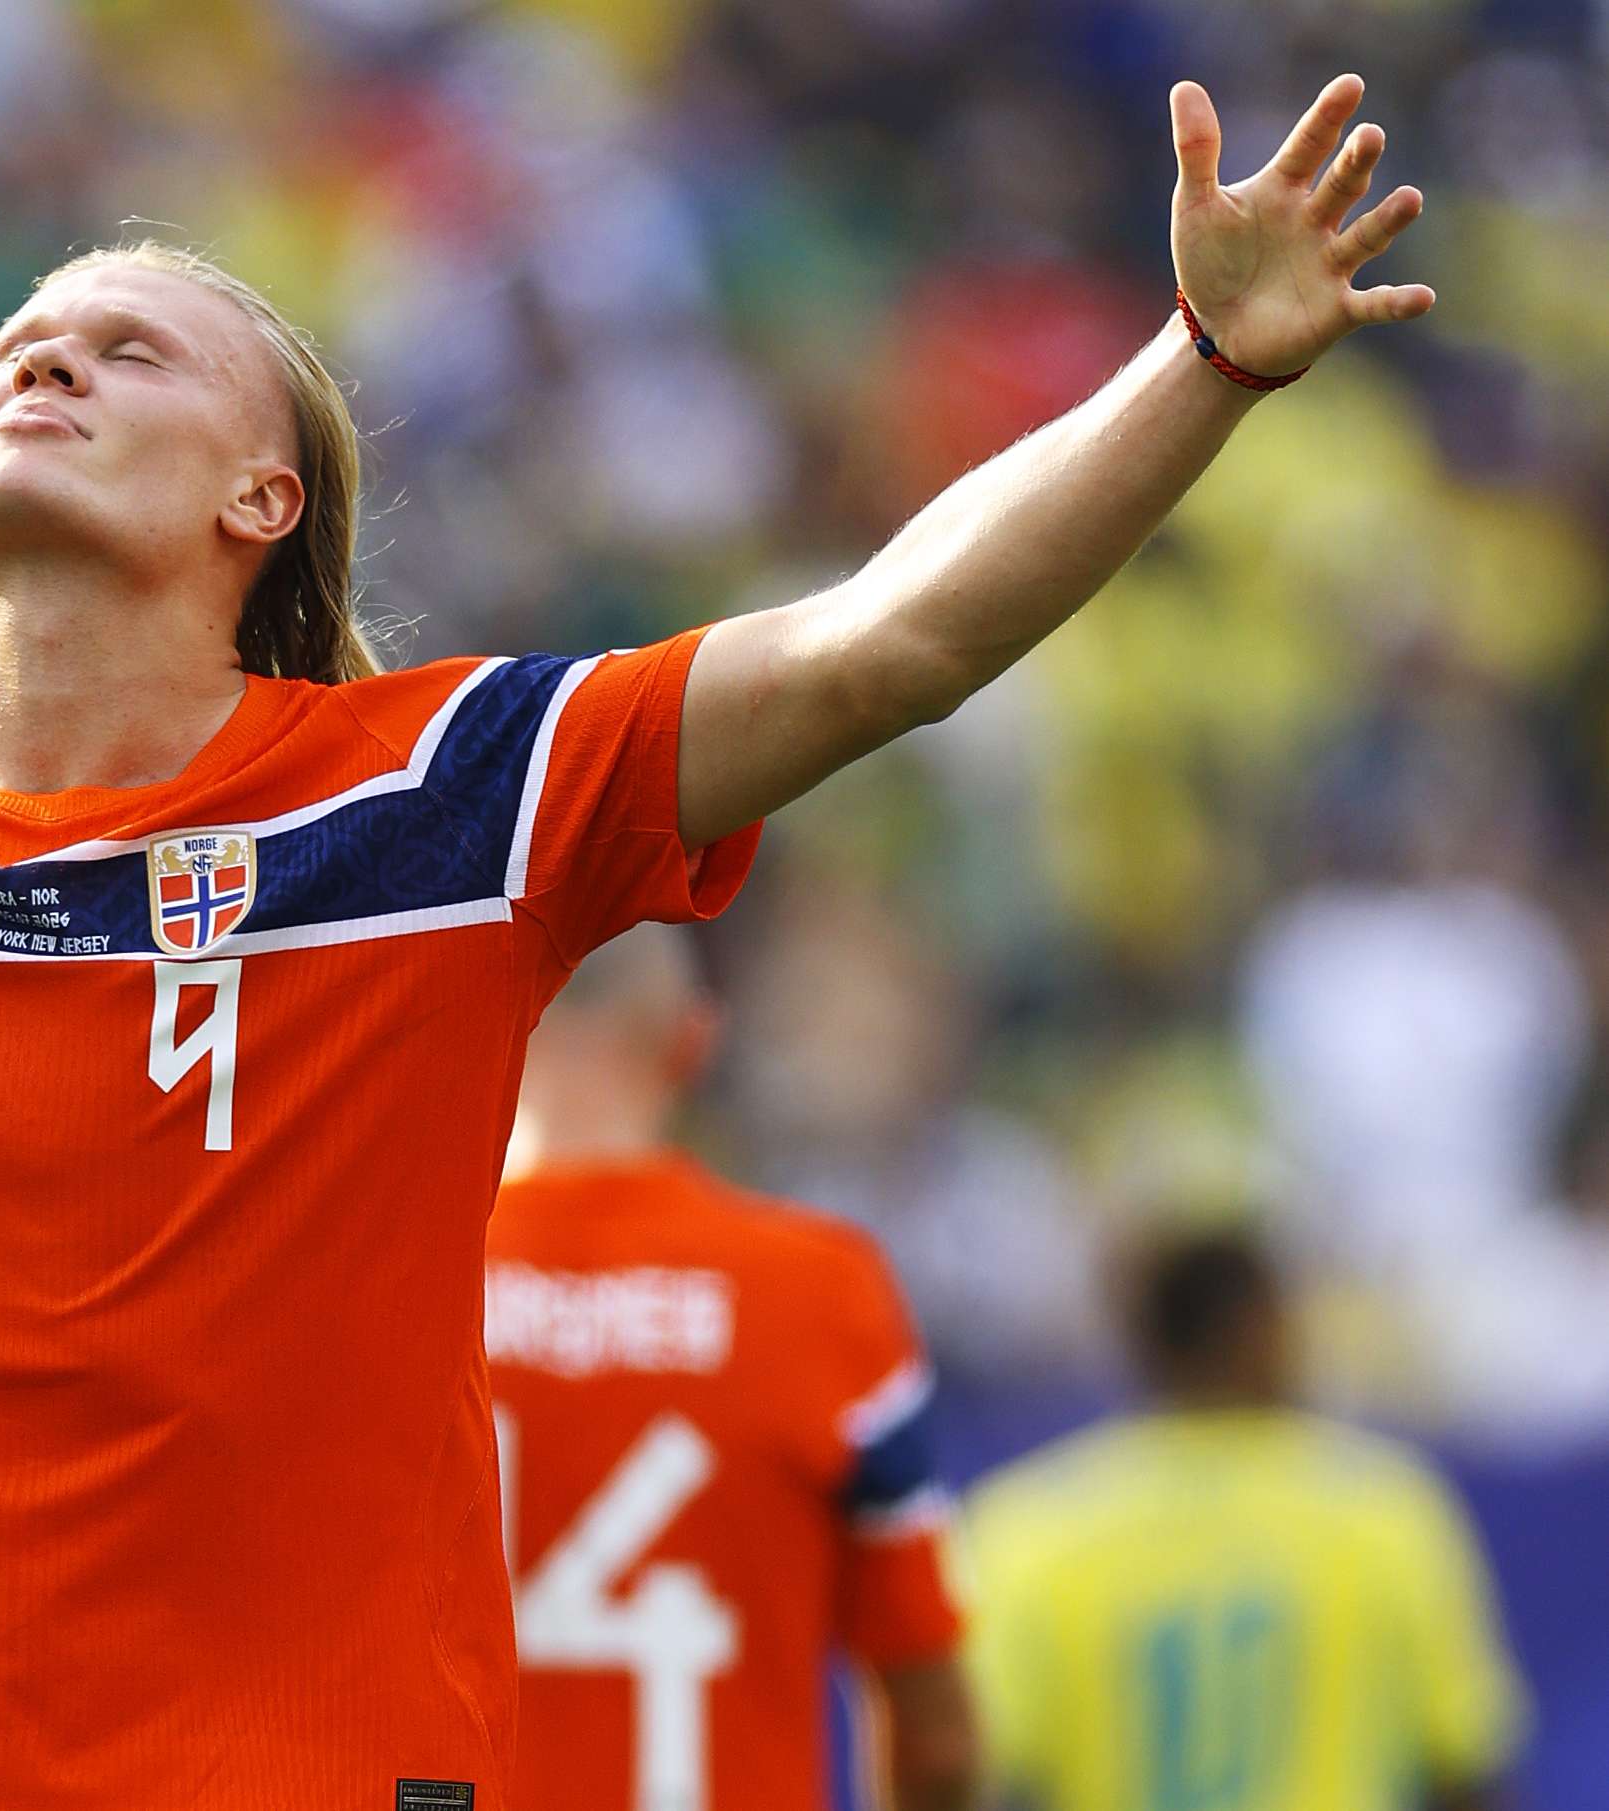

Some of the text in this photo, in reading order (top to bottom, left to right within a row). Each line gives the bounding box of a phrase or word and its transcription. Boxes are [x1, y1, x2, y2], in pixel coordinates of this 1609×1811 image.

[184, 837, 217, 853] NORGE
[31, 888, 60, 905] NOR
[31, 934, 57, 952] NEW
[60, 935, 110, 953] JERSEY
[148, 958, 242, 1151] 9
